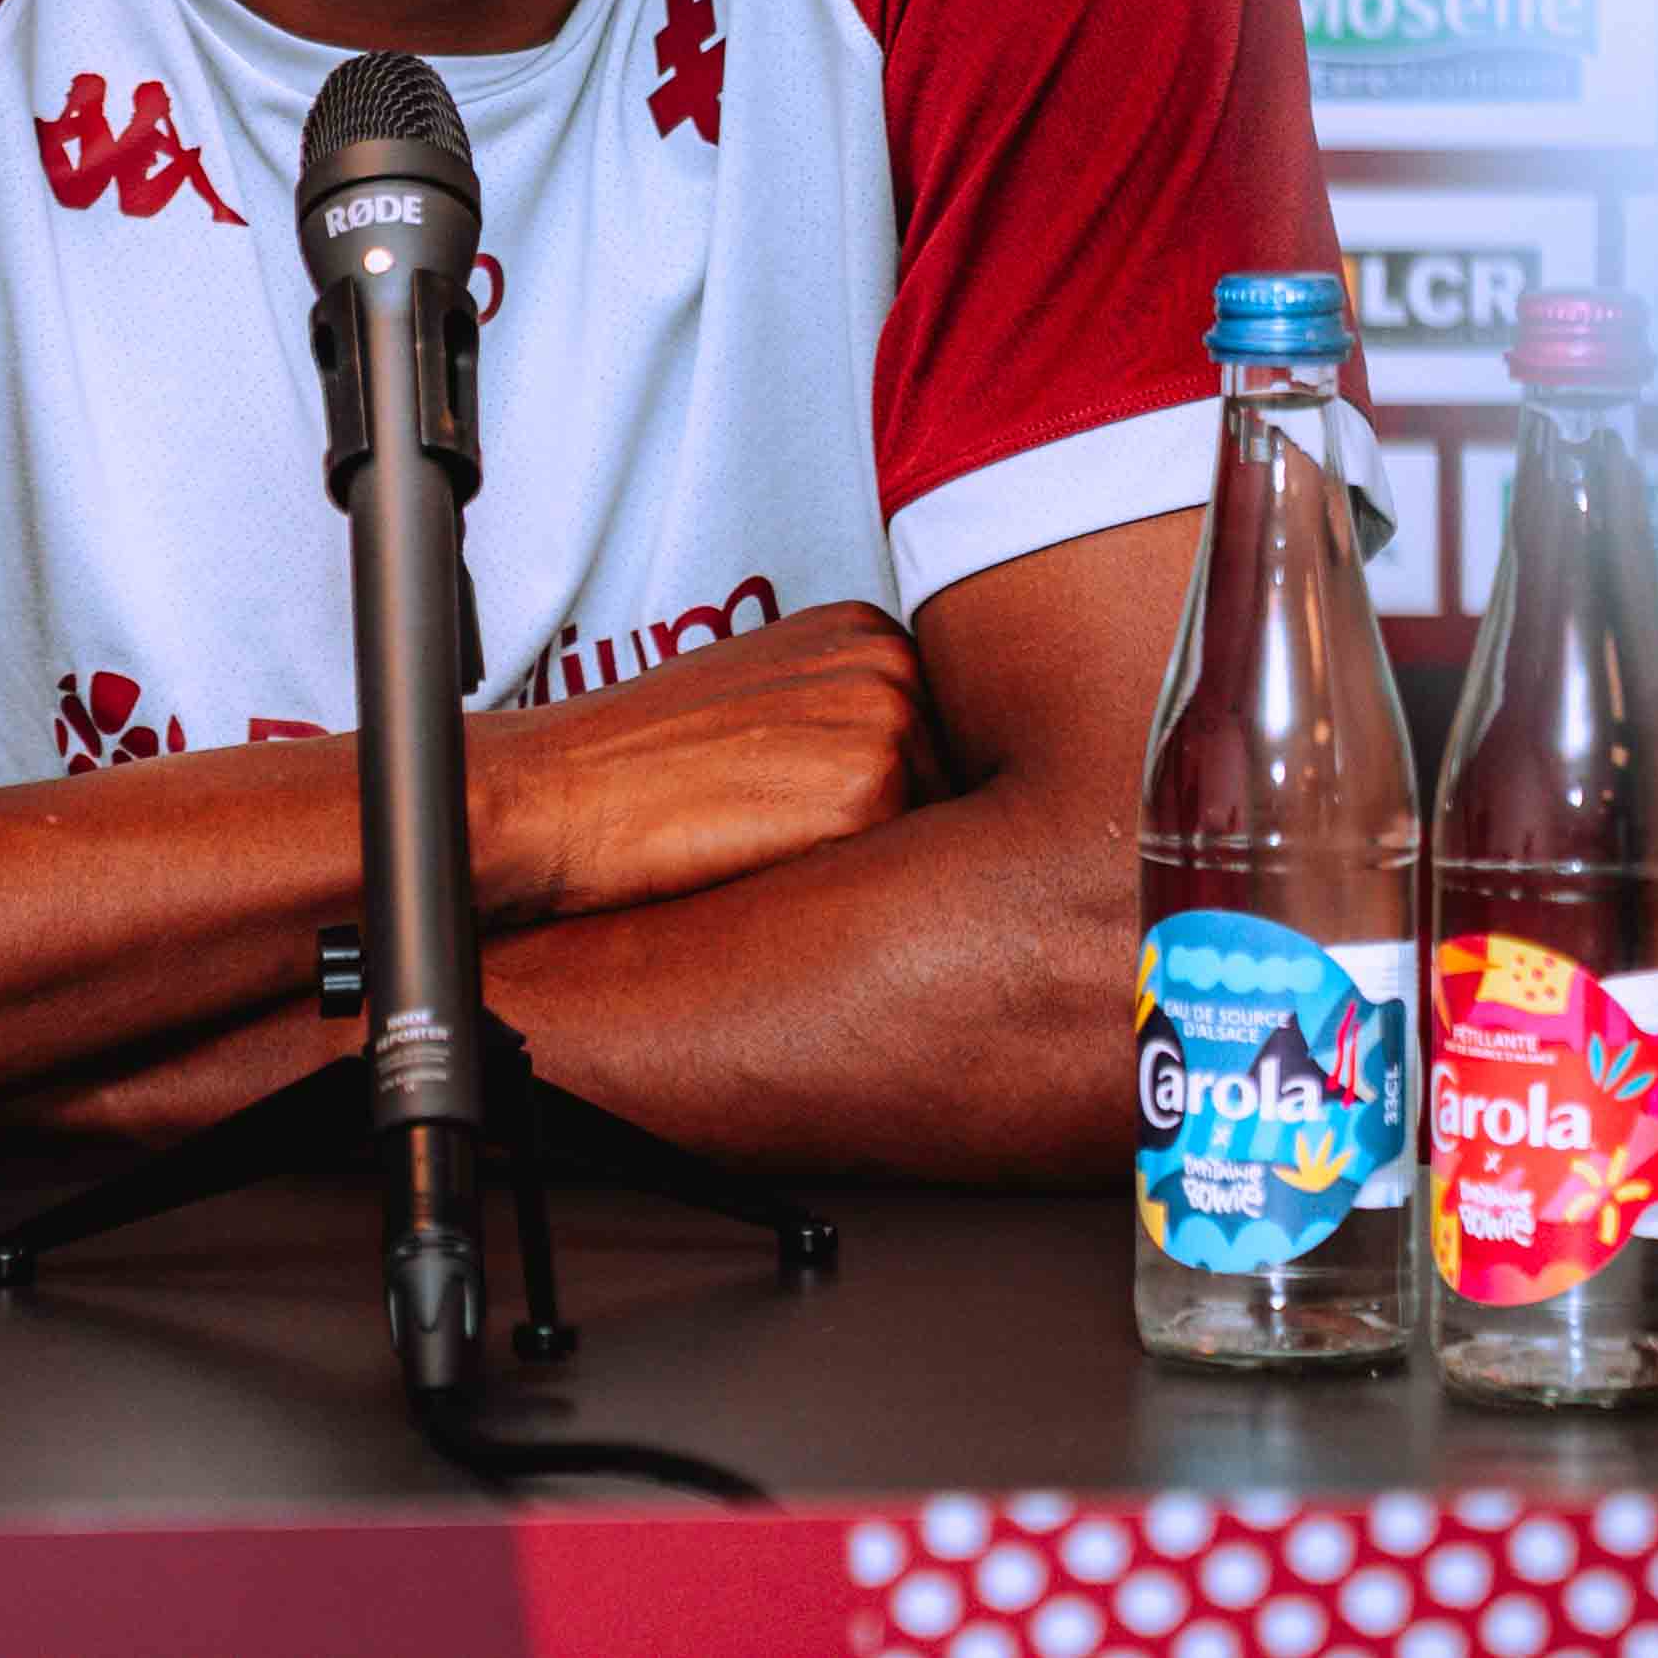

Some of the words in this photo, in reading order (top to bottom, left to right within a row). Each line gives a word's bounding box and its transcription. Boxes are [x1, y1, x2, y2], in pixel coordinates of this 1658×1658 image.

[324, 196, 423, 239] RØDE
[1362, 256, 1525, 328] LCR
[1140, 1039, 1324, 1130] Carola
